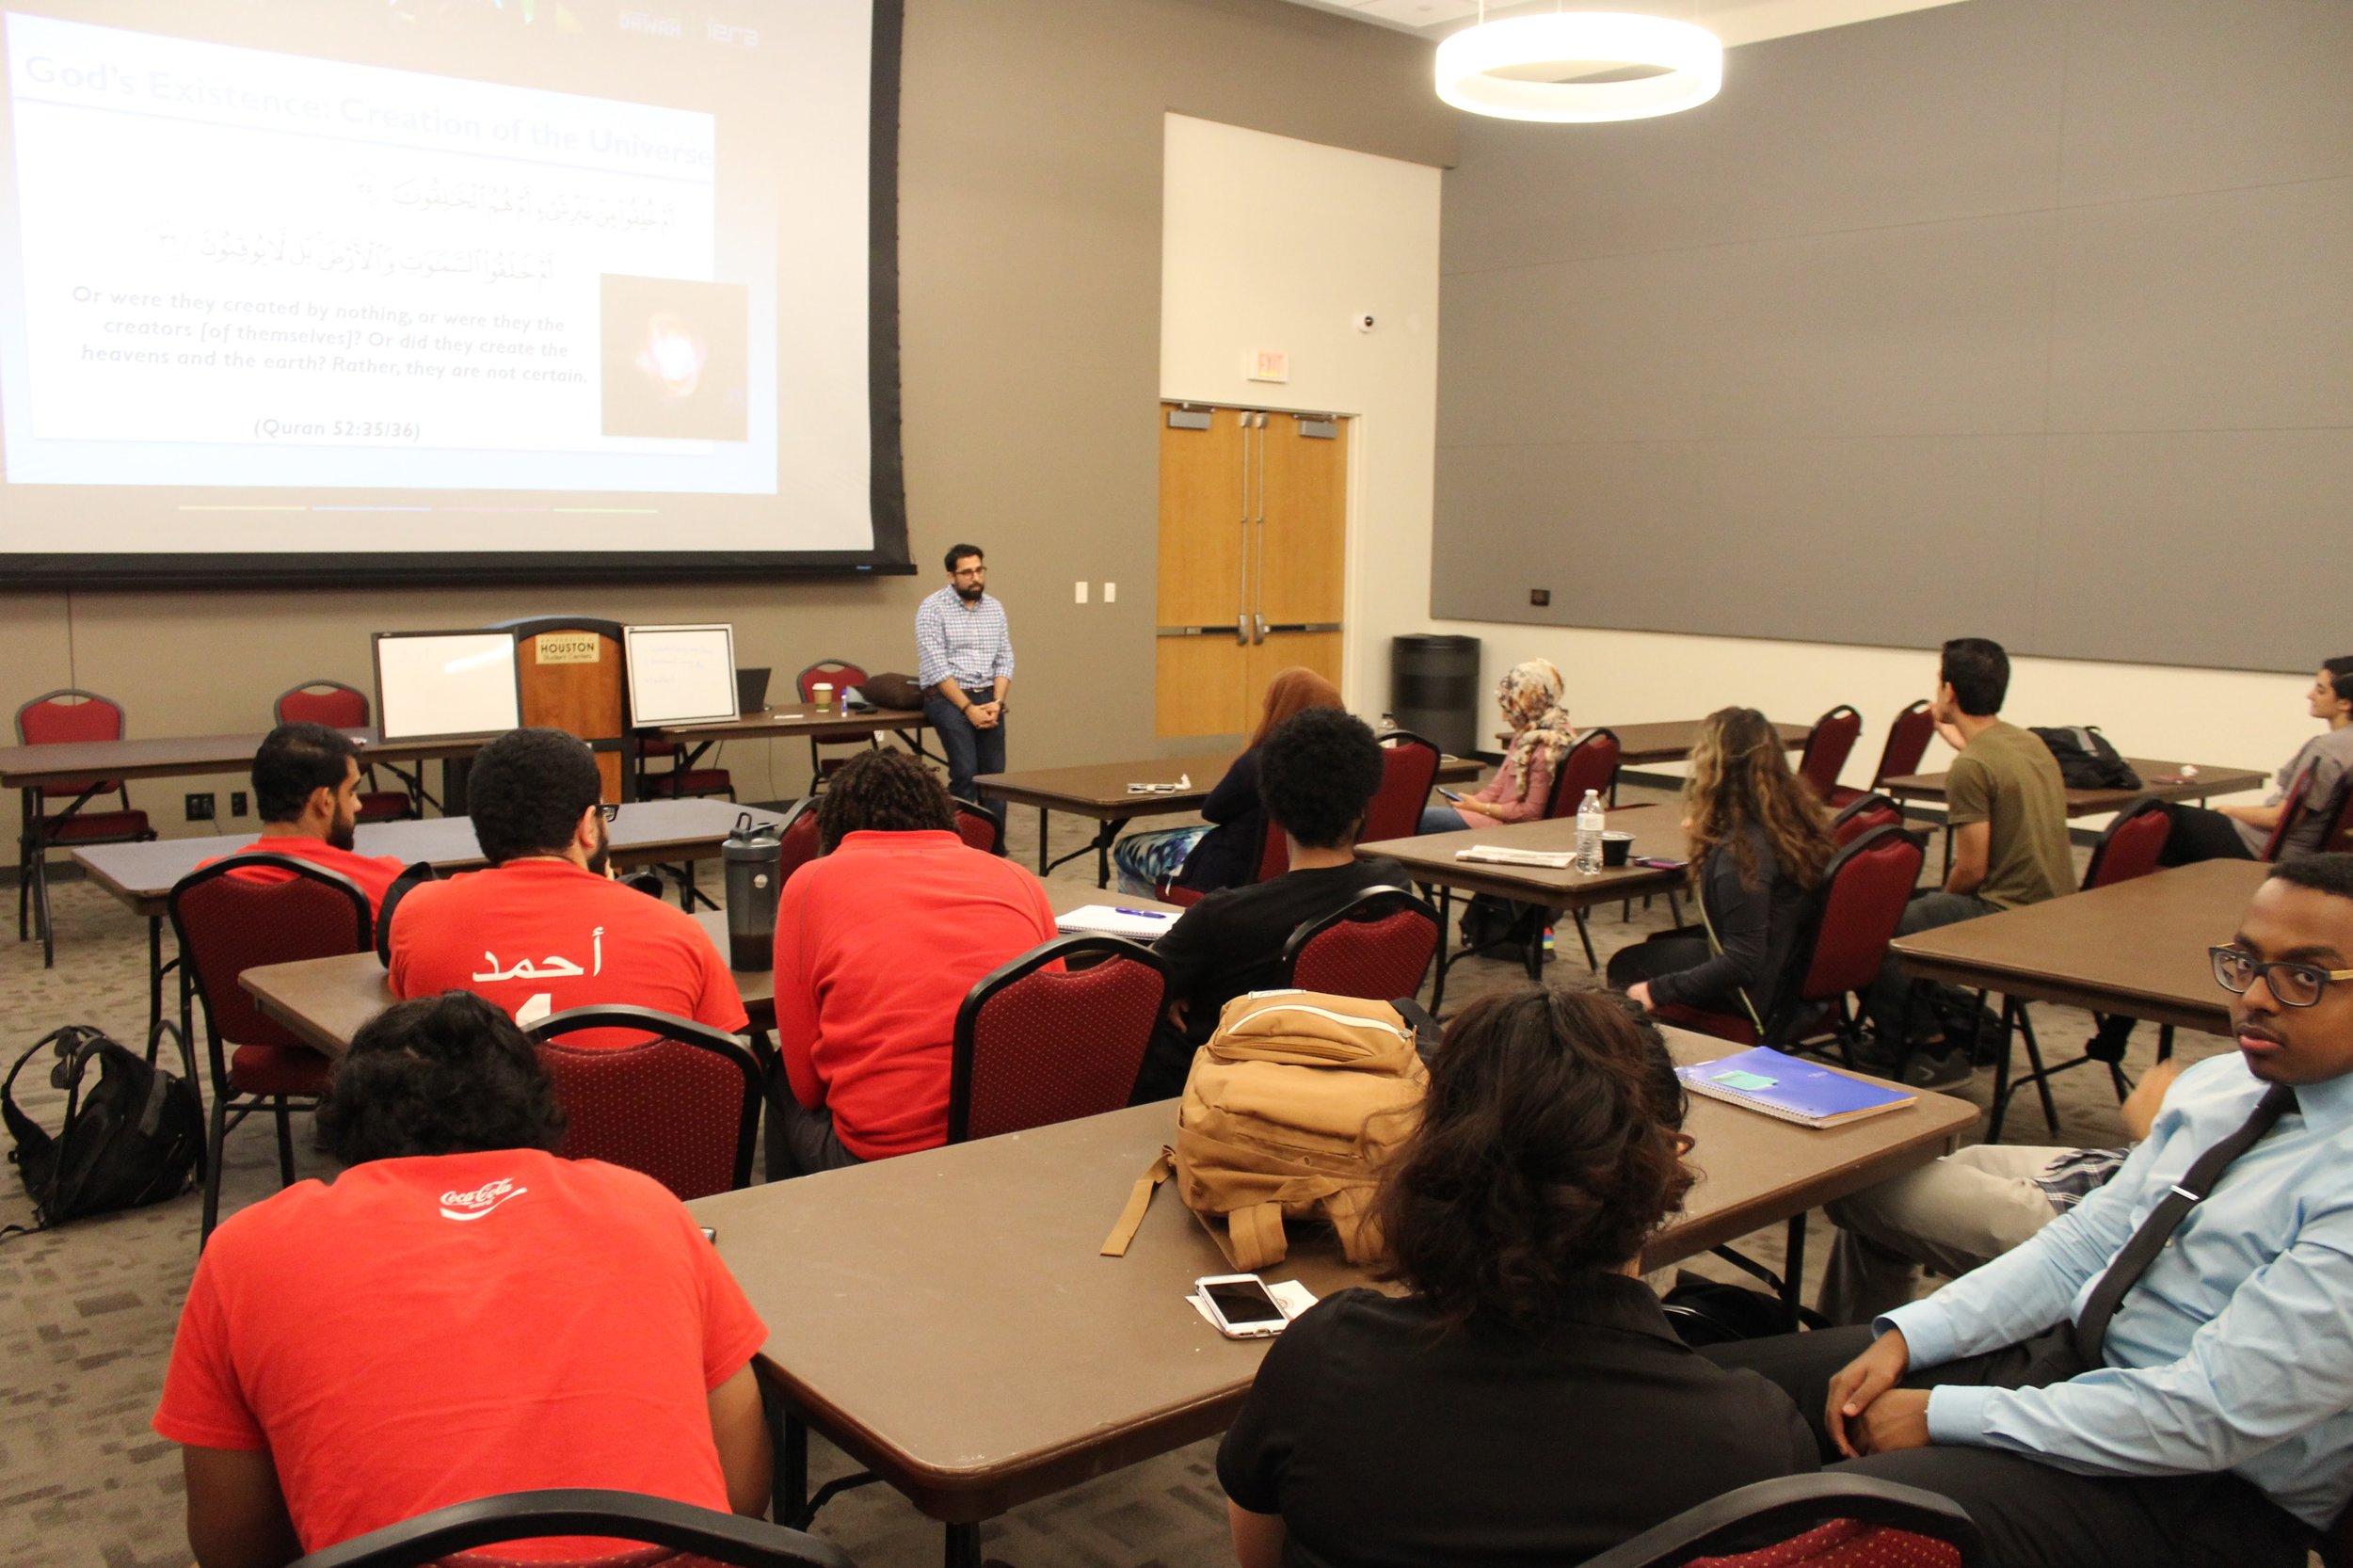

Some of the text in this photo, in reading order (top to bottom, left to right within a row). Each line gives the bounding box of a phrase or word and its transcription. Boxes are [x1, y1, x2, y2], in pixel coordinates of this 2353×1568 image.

[25, 56, 713, 168] God's Existence: Creation of the Universe
[72, 285, 565, 333] Or were they created by nothing, or were they the
[104, 320, 568, 358] creators [of themselves]? Or did they create the
[81, 344, 588, 384] heavens and the earth? Rather, they are not certain.
[254, 418, 421, 441] (Quran 52:35/36)
[540, 642, 594, 654] HOUSTON
[472, 926, 605, 983] أحمد
[440, 1176, 515, 1206] Coca-Cola
